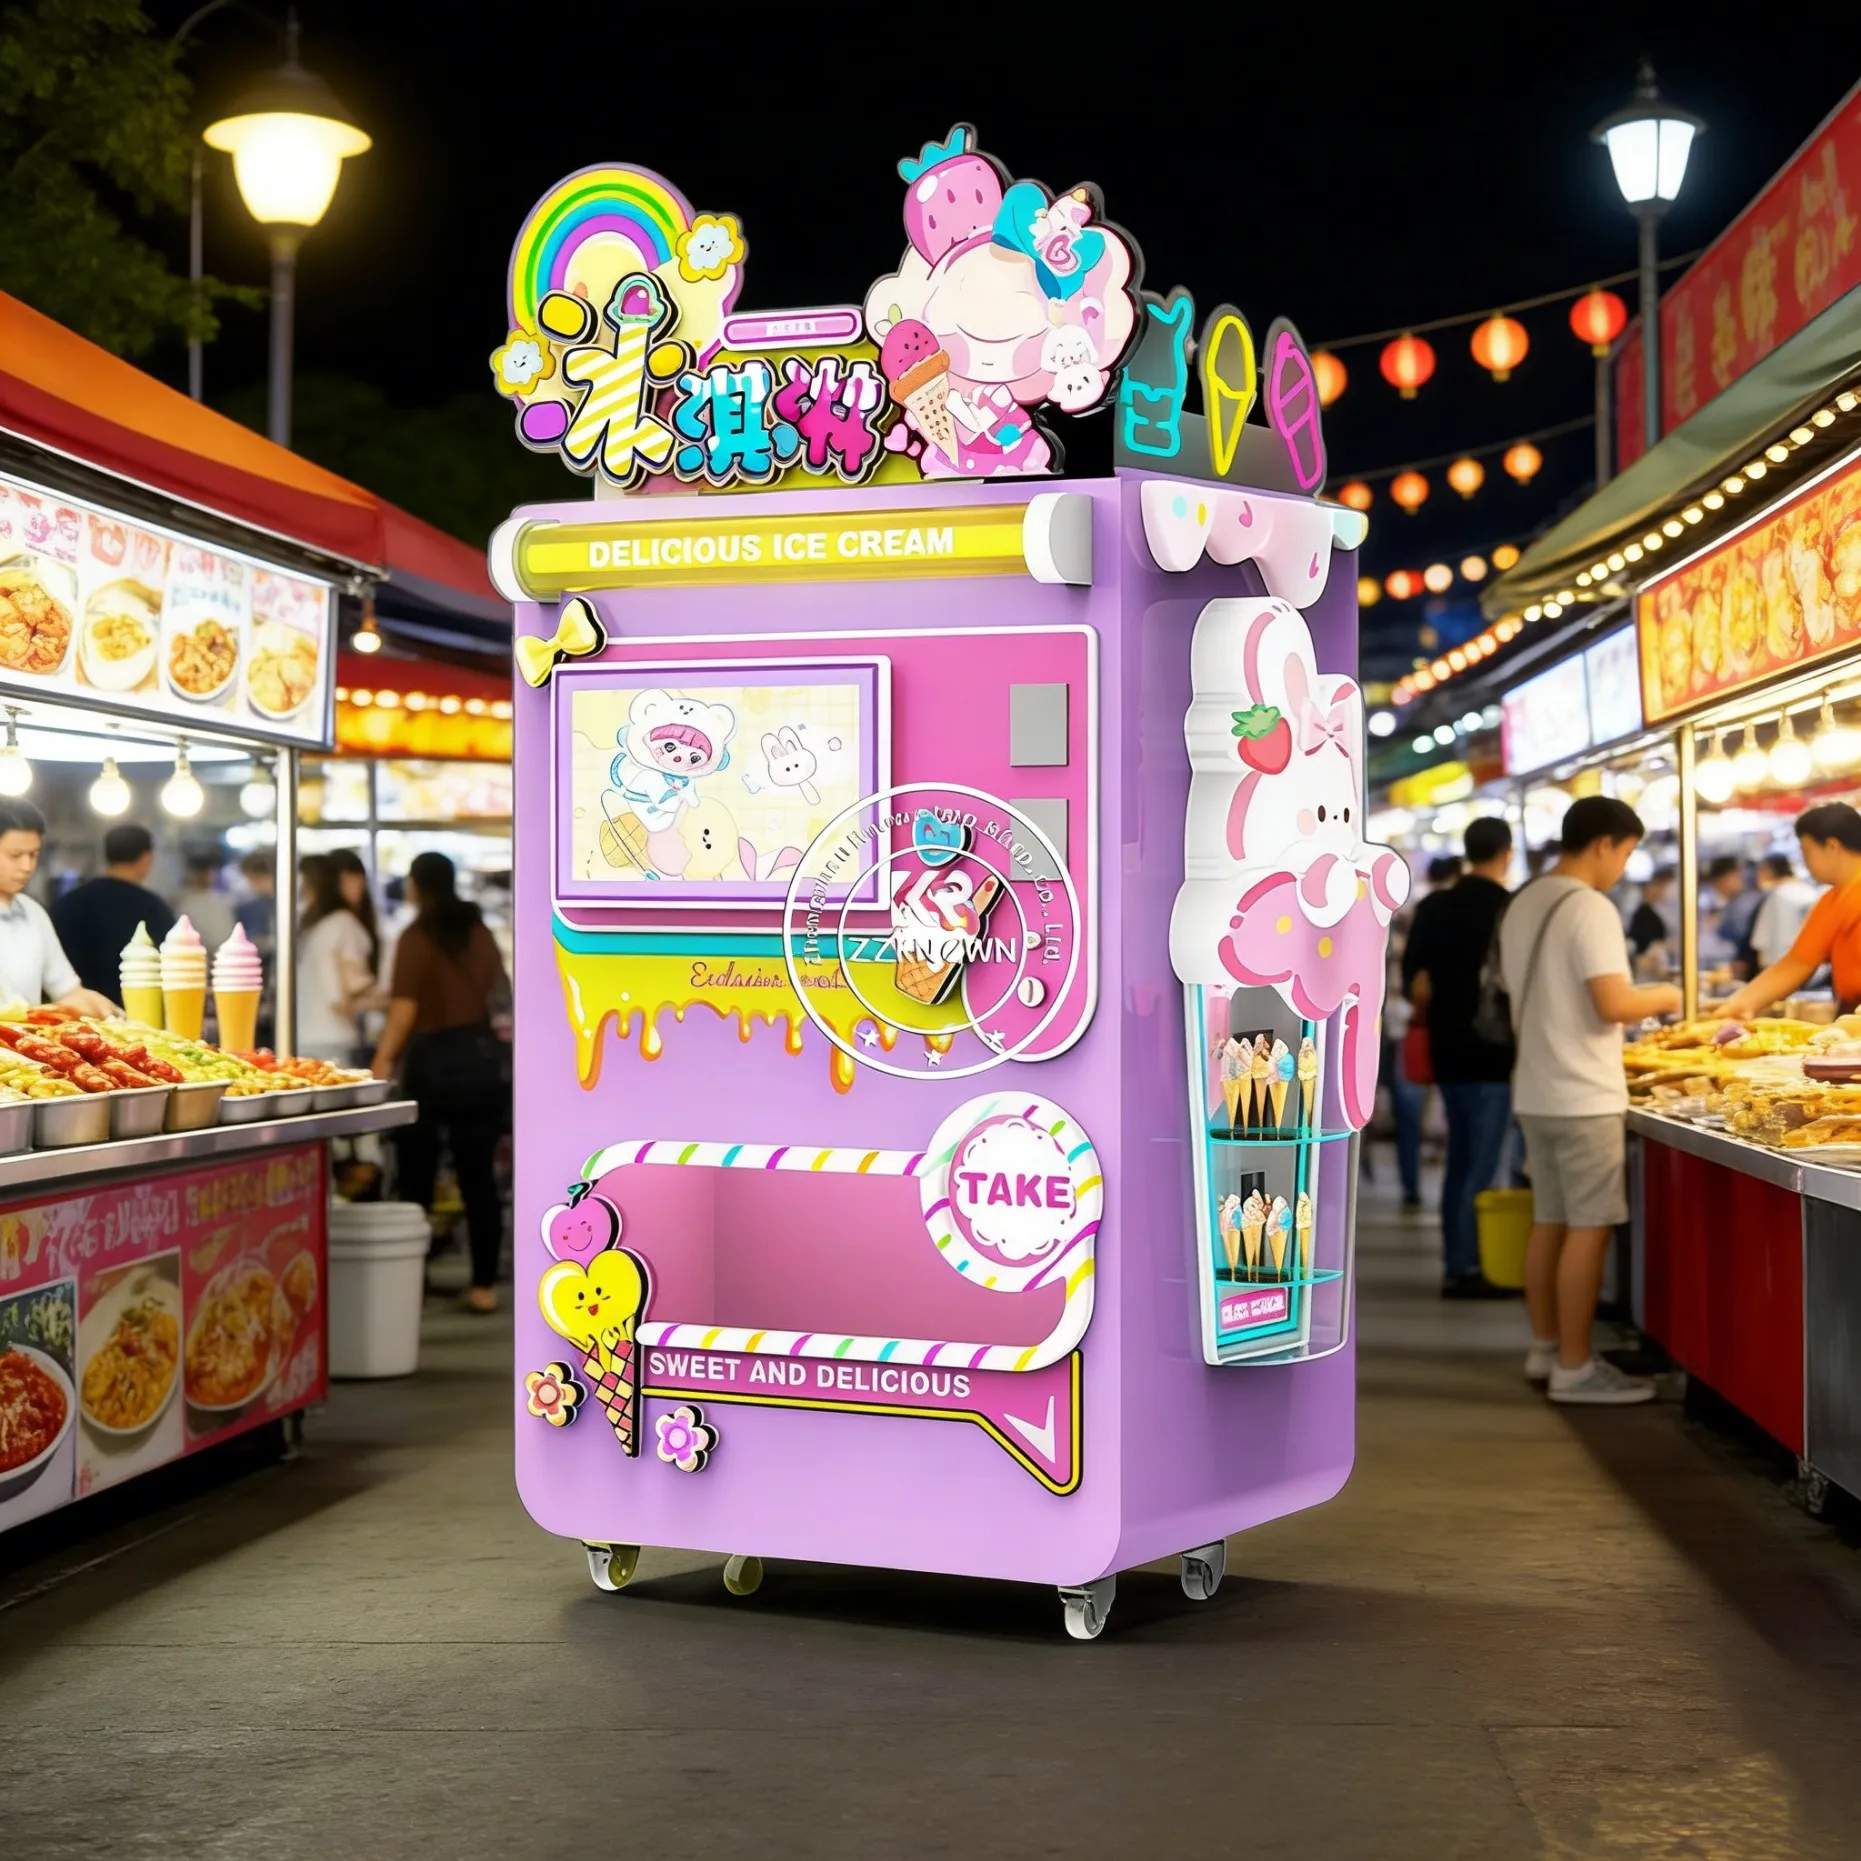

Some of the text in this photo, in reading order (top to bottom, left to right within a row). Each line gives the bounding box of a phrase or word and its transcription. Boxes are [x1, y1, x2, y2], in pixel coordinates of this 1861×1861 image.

[589, 527, 955, 569] DELICIOUS ICE CREAM
[959, 1172, 1071, 1208] TAKE
[649, 1352, 972, 1398] SWEET AND DELICIOUS
